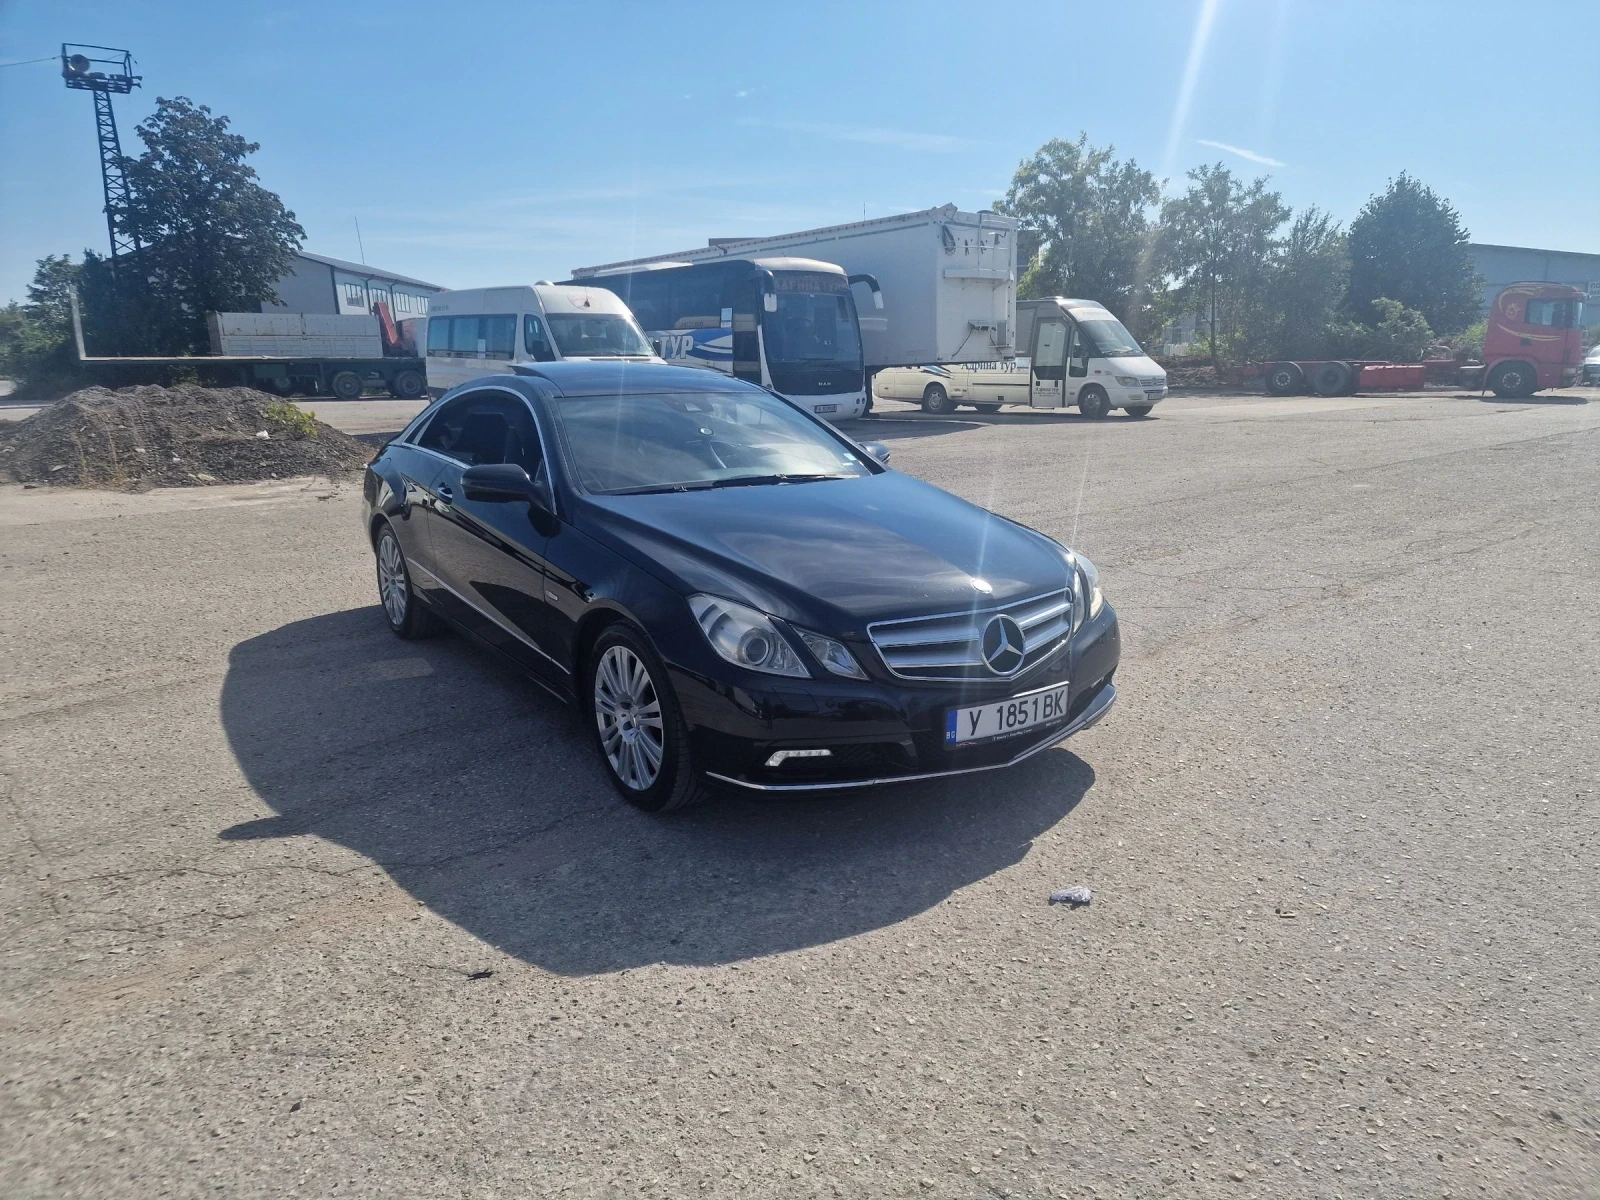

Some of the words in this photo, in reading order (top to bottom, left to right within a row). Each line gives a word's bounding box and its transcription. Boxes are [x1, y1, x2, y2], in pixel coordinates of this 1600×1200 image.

[660, 335, 694, 359] ТУР
[969, 709, 982, 736] Y
[946, 731, 956, 740] BG
